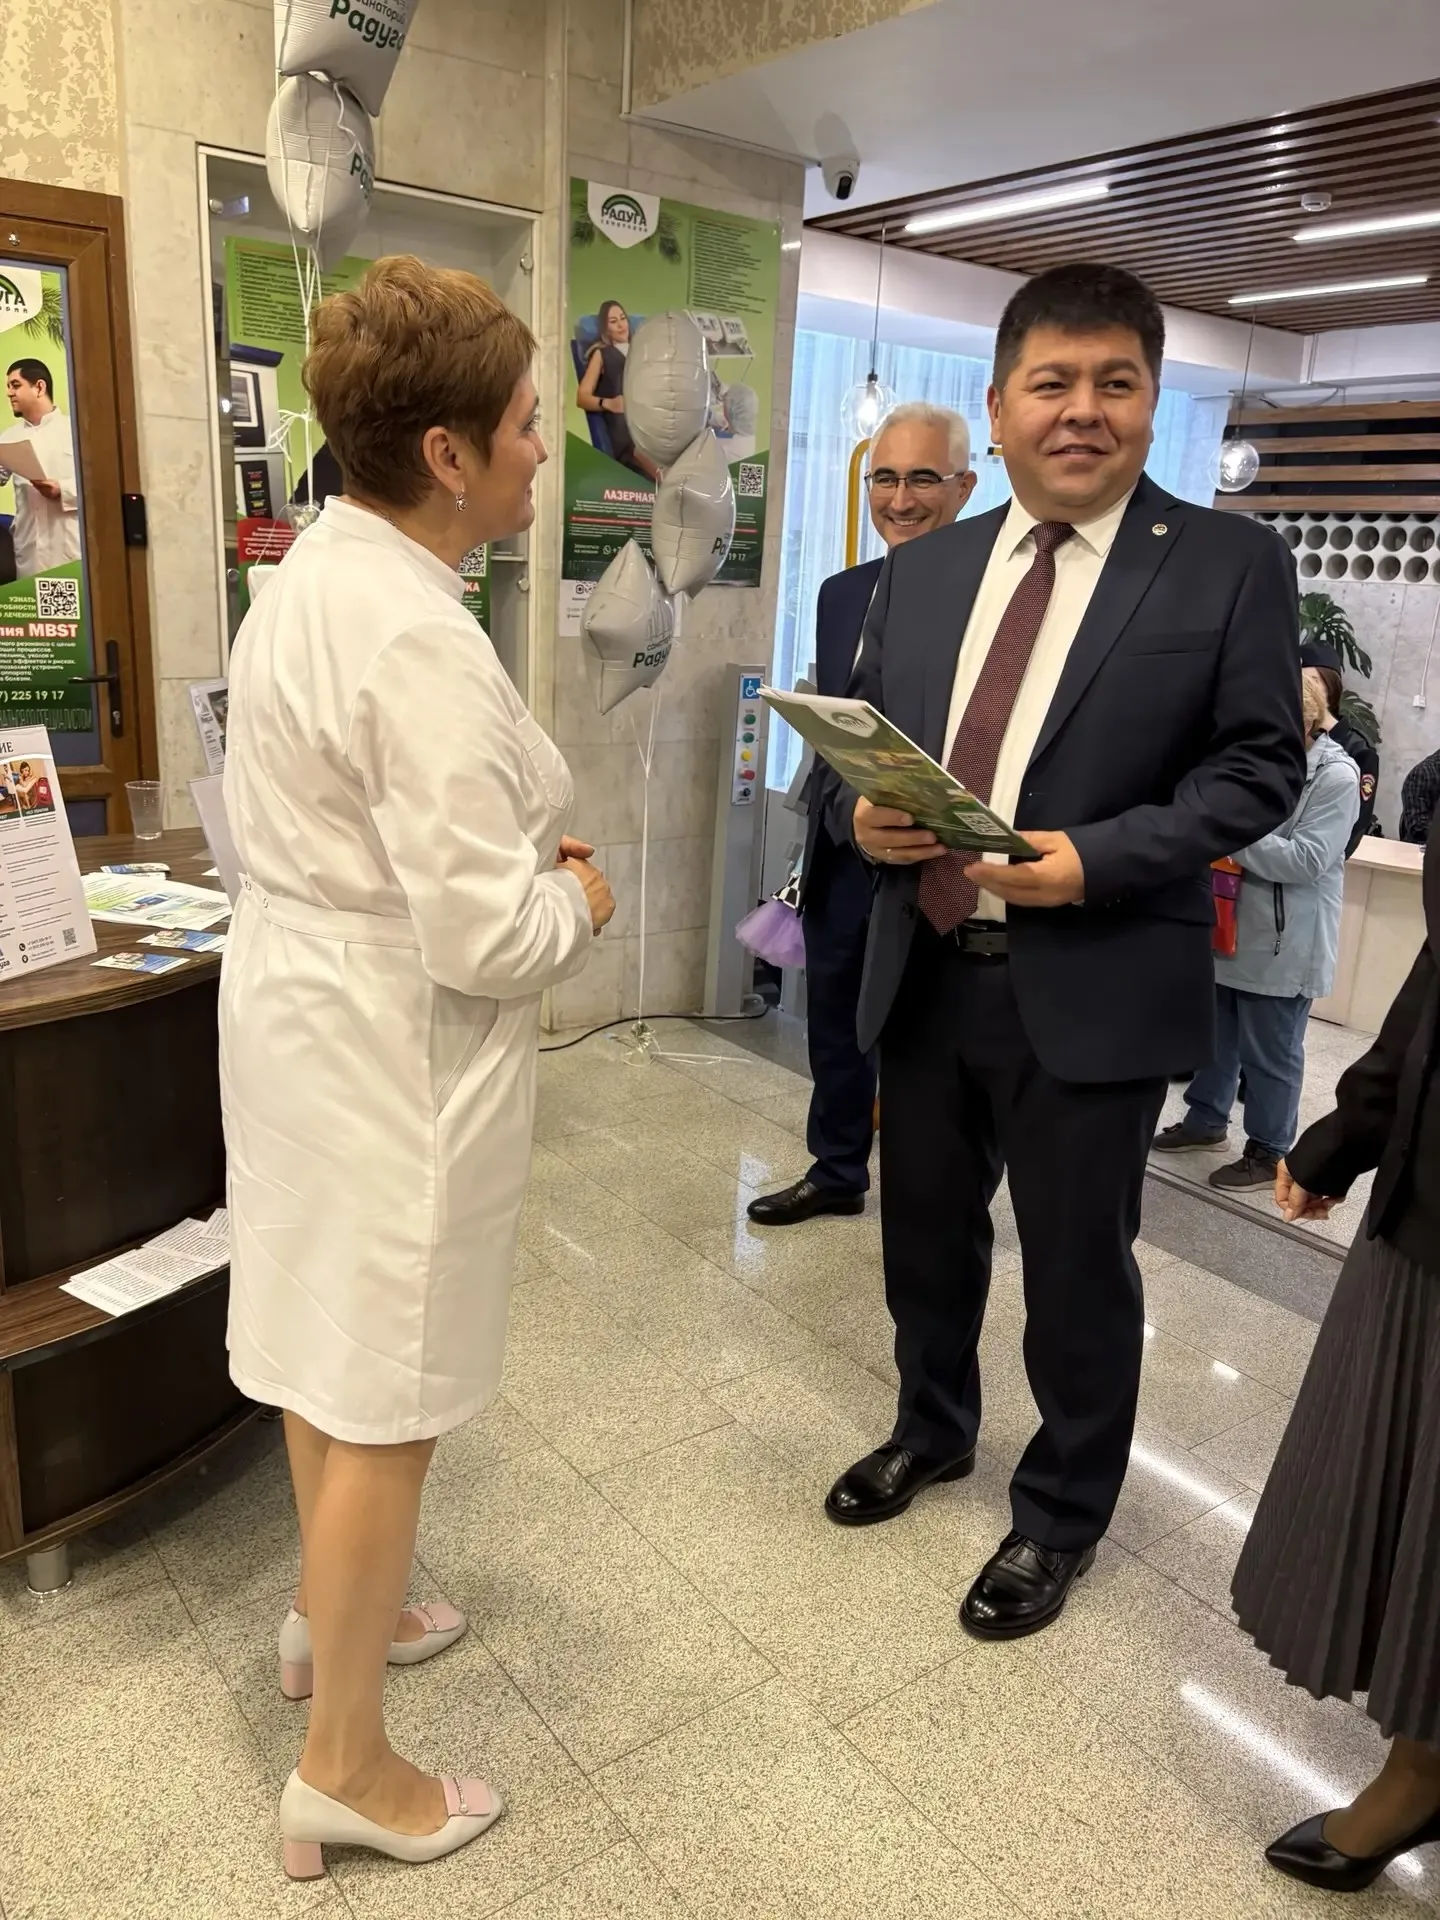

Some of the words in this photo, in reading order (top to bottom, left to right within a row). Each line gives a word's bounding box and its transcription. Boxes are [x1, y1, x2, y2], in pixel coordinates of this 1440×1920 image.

[601, 206, 647, 227] РАДУГА
[603, 488, 656, 504] ЛАЗЕРНАЯ
[465, 581, 480, 593] КА
[28, 623, 78, 638] MBST
[11, 690, 32, 701] 225
[35, 690, 48, 701] 19
[51, 690, 65, 701] 17
